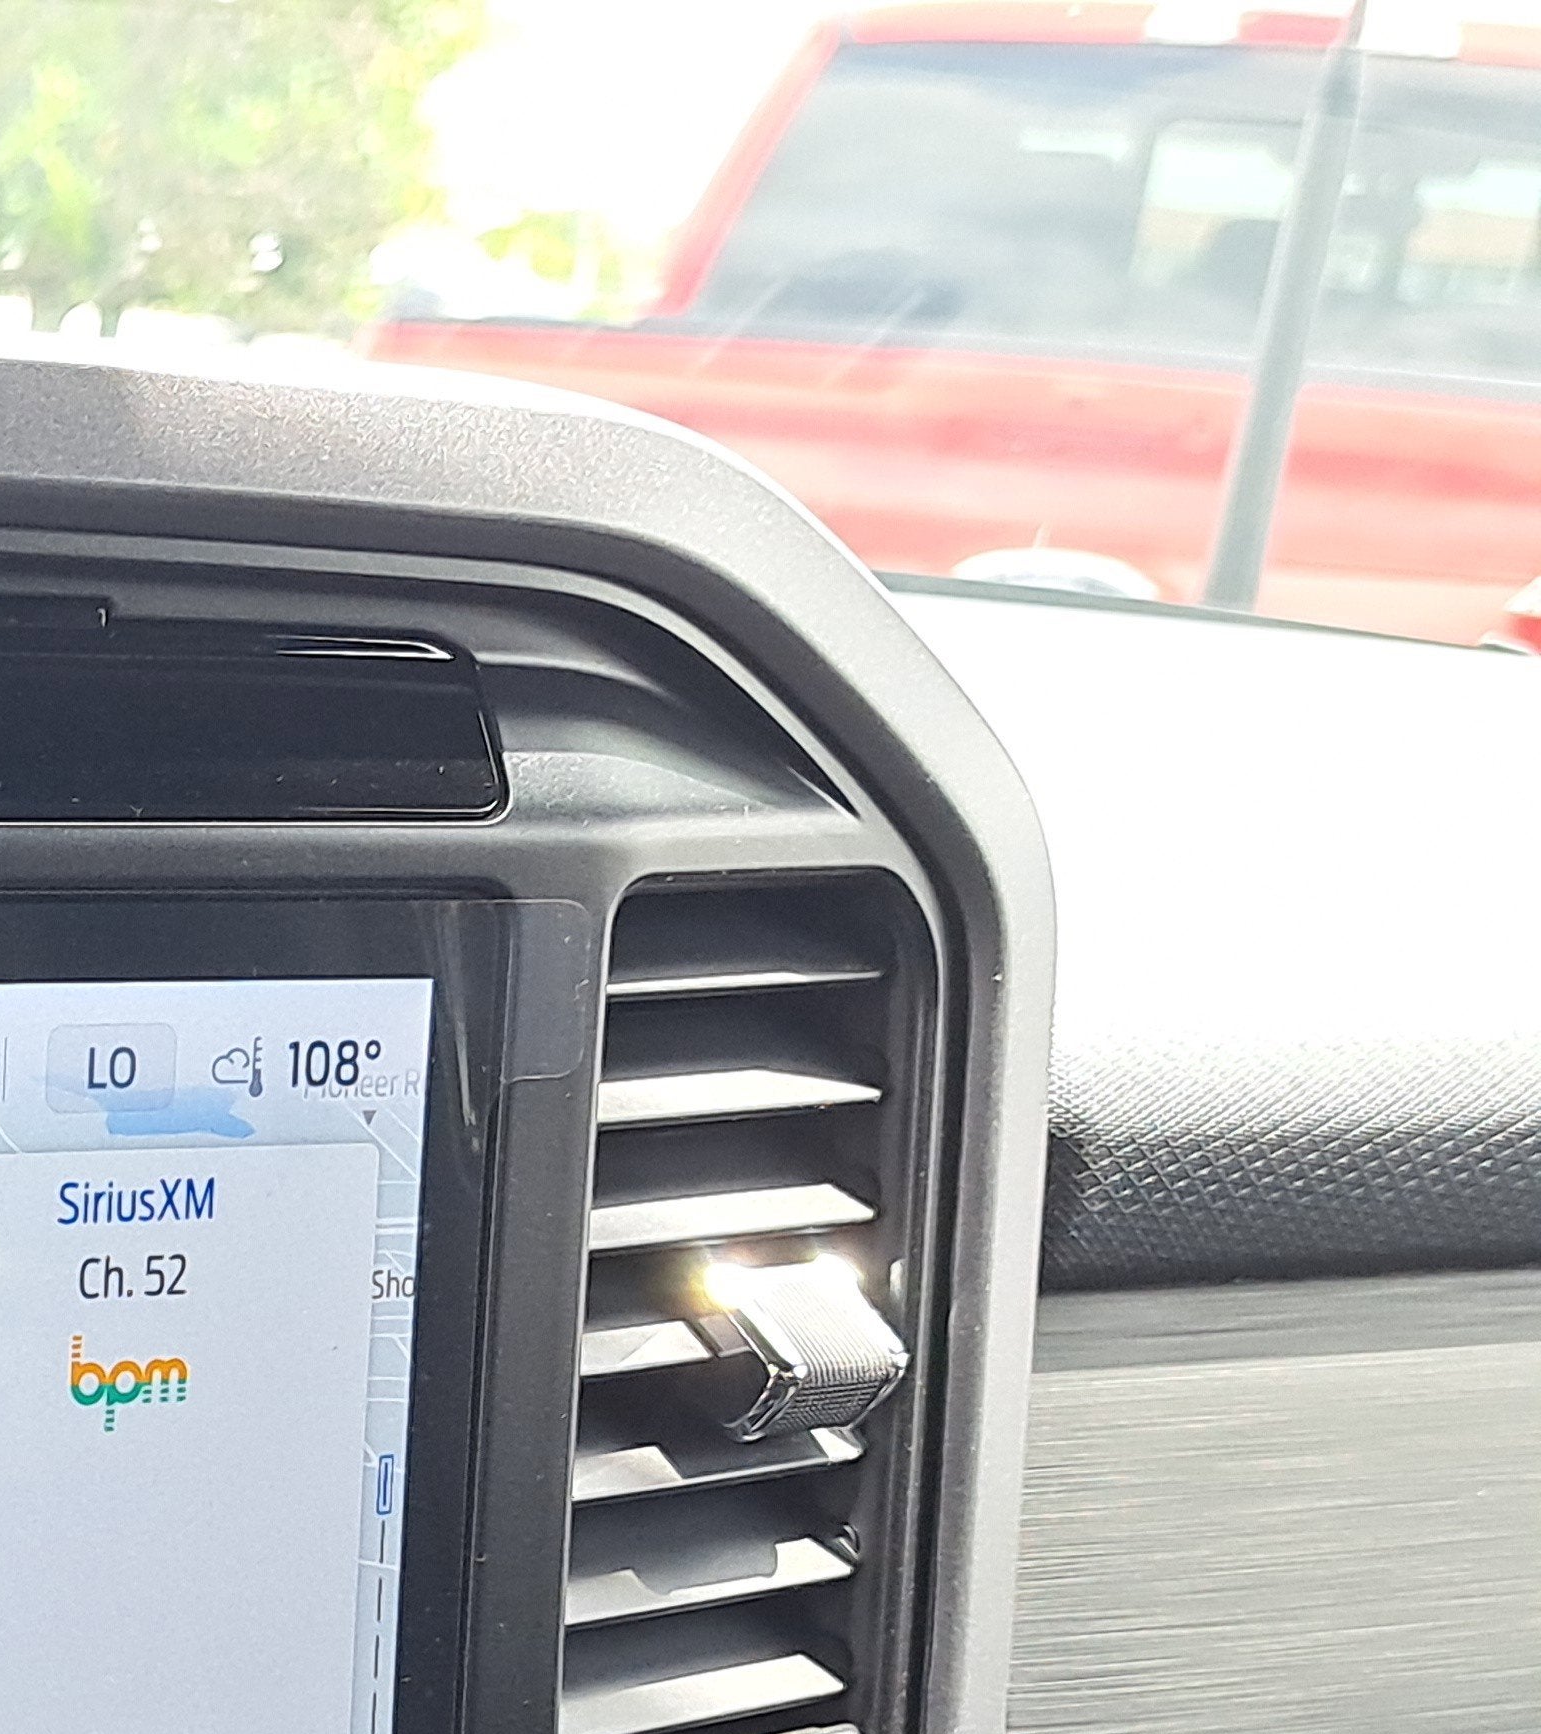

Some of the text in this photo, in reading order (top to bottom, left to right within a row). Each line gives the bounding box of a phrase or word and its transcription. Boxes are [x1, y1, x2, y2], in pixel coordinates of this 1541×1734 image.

[87, 1046, 137, 1092] LO
[56, 1177, 216, 1225] SiriusXM
[78, 1254, 188, 1300] Ch. 52
[69, 1334, 189, 1432] bpm
